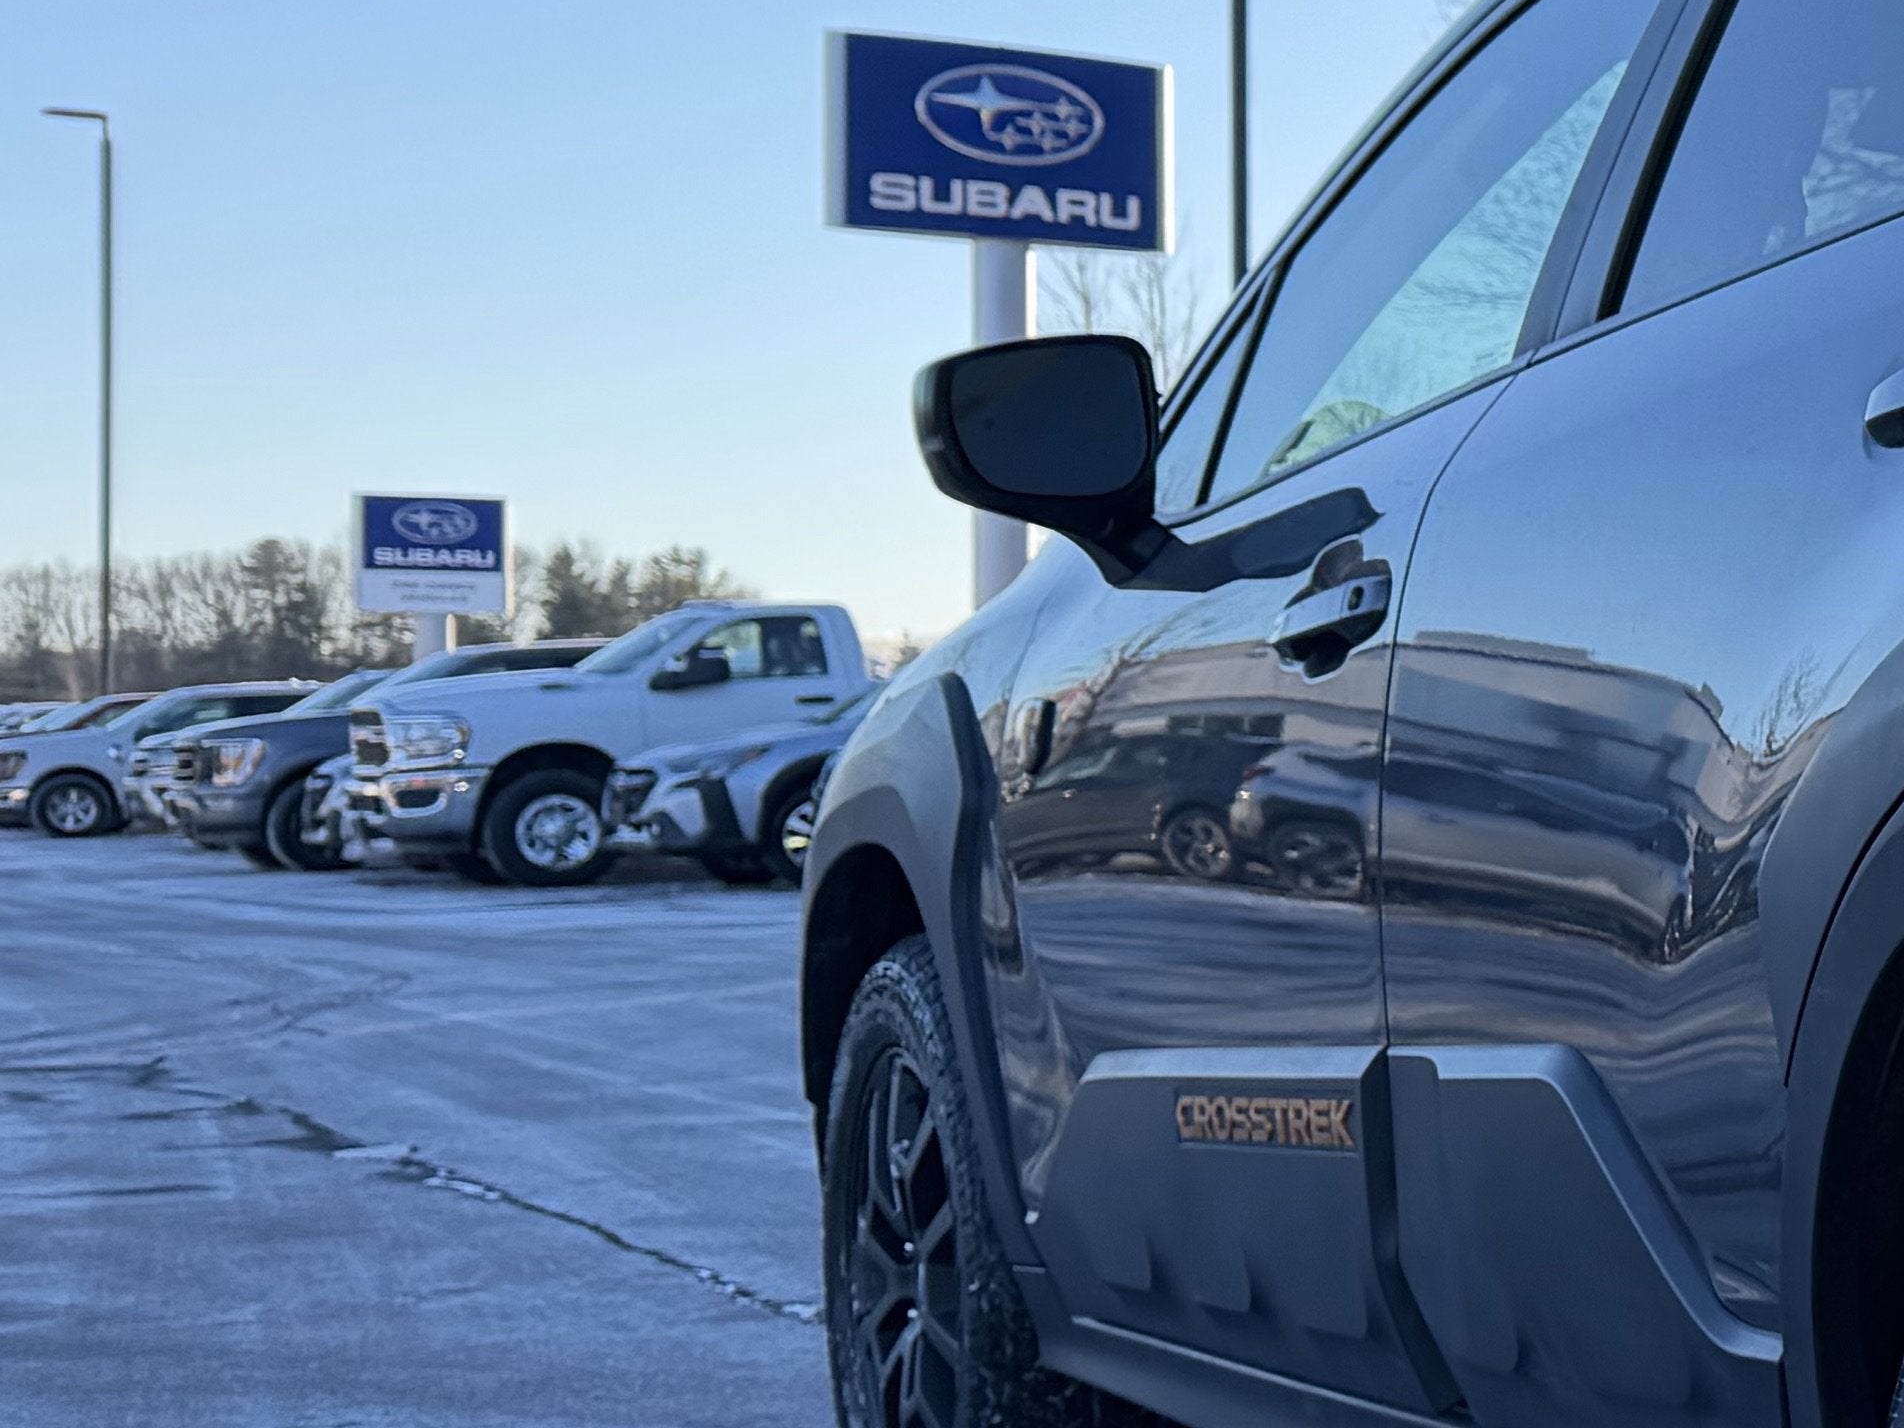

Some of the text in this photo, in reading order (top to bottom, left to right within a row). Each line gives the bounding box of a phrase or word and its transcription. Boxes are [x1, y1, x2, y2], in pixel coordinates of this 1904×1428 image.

[868, 172, 1142, 232] SUBARU
[373, 546, 496, 568] SUBARU
[1175, 1094, 1355, 1148] CROSSTREK
